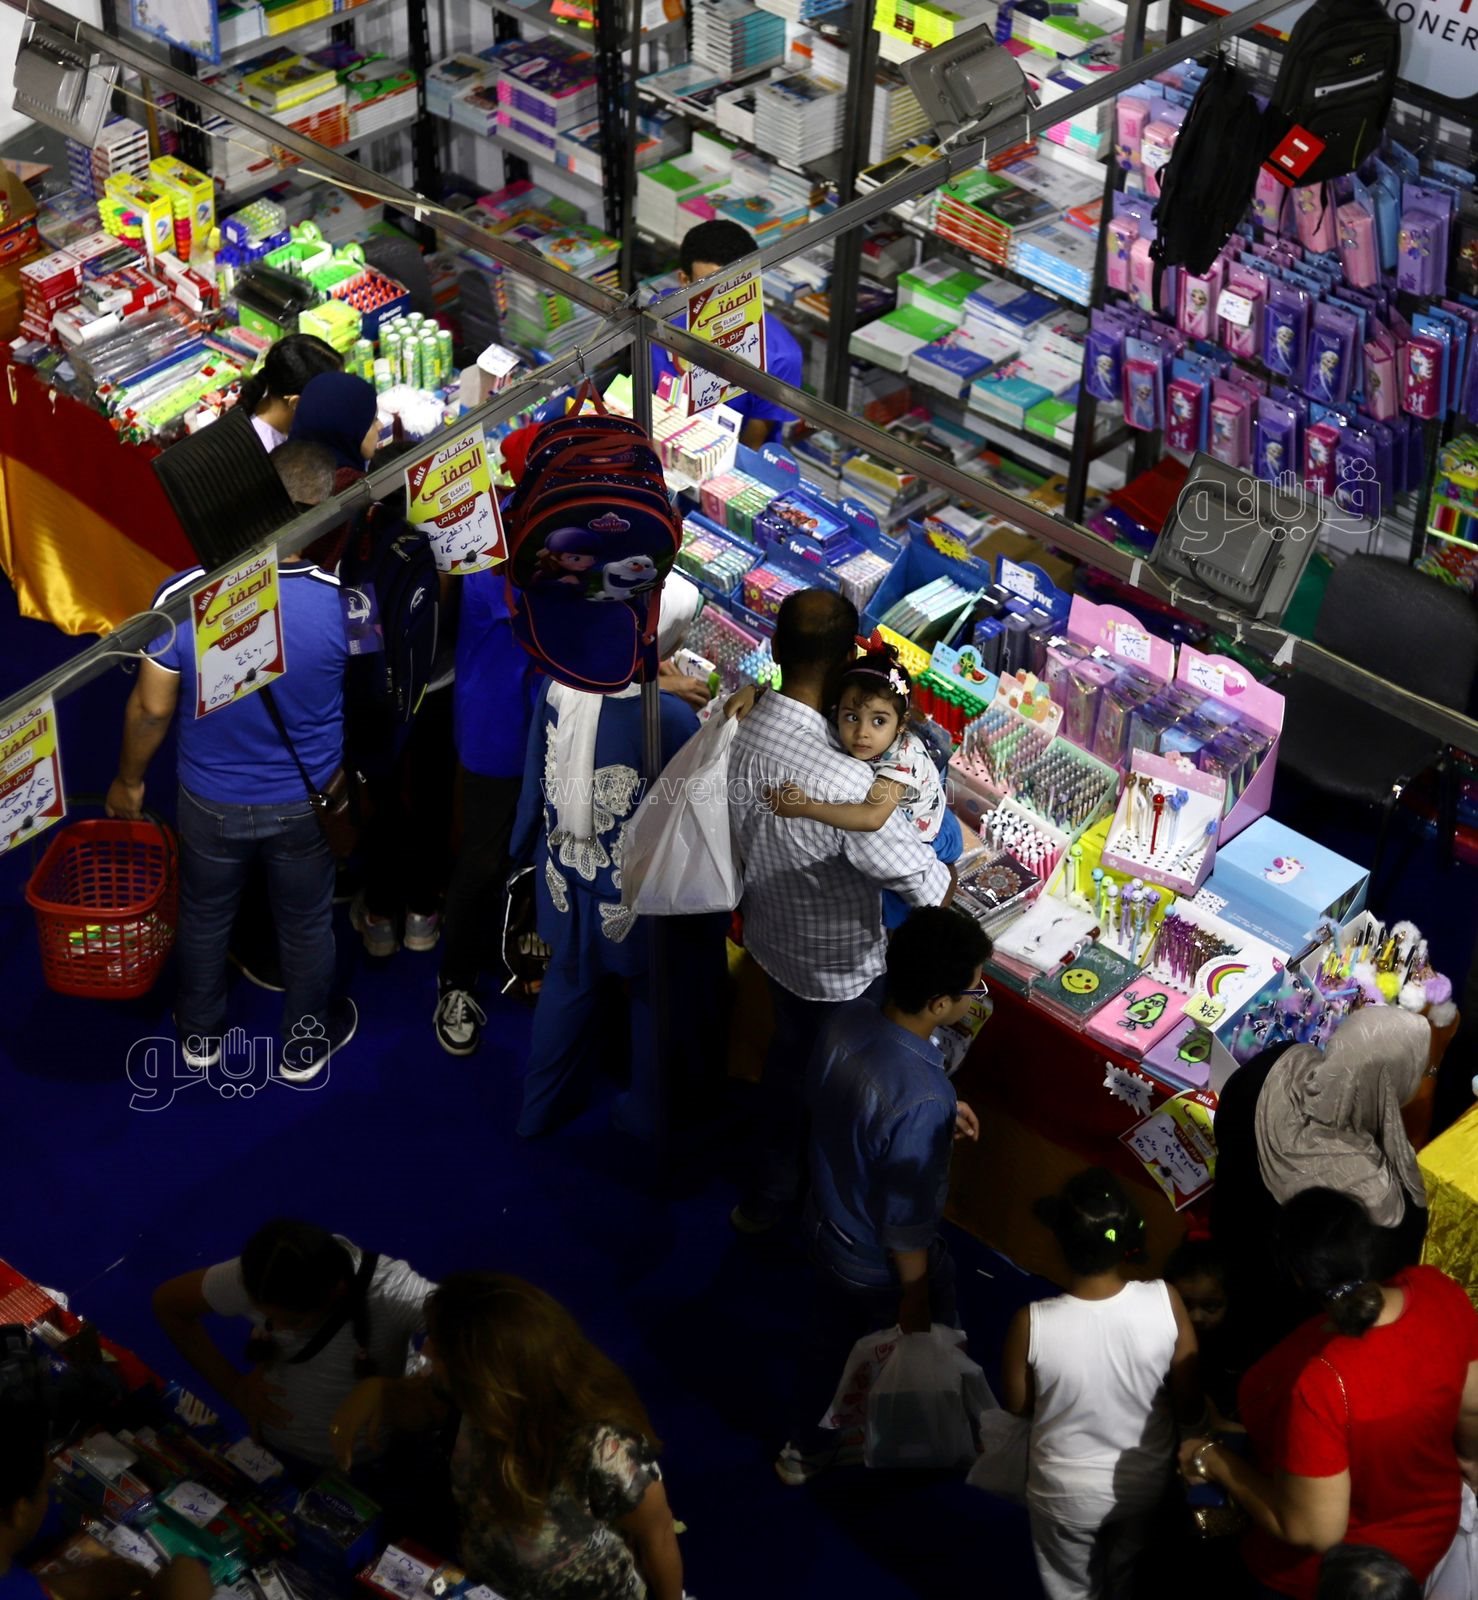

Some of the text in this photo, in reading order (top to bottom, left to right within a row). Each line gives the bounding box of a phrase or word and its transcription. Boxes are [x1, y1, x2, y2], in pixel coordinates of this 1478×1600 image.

[718, 271, 753, 295] مكتبات
[727, 329, 744, 344] عرض
[438, 437, 474, 464] مكتبات
[413, 466, 426, 487] SALE
[449, 480, 470, 499] ELSAFTY
[438, 500, 474, 527] عرض خاص
[227, 558, 267, 588] مكتبات
[199, 591, 213, 611] SALE
[234, 601, 256, 619] ELSAFTY
[221, 620, 258, 649] عرض خاص
[0, 717, 48, 762] الصفت
[14, 768, 33, 786] عرض
[1196, 1093, 1214, 1106] SALE
